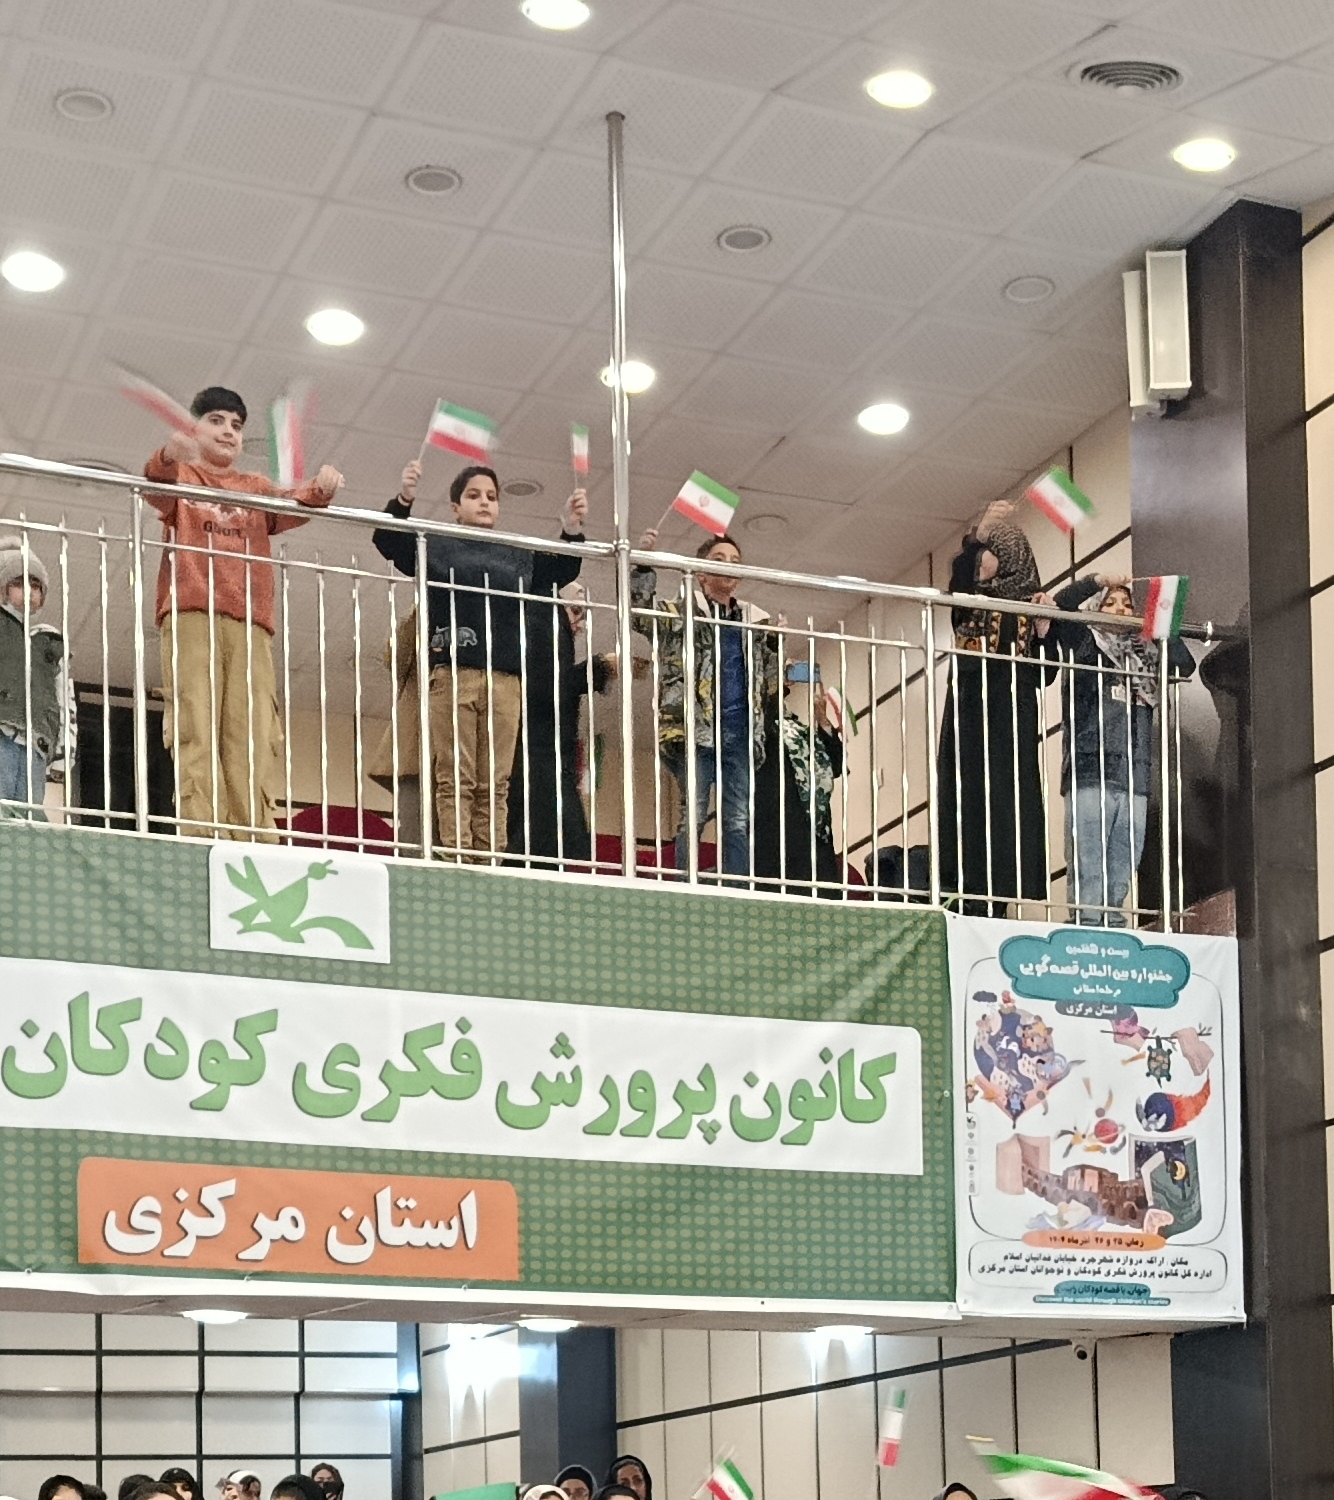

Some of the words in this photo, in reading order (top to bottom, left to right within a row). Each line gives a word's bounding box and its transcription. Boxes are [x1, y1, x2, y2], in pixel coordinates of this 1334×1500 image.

[1131, 967, 1173, 984] جشنواره
[1066, 1003, 1093, 1015] مرکزی
[1095, 1004, 1117, 1016] استان
[0, 991, 279, 1112] کودکان
[292, 1016, 483, 1122] فکری
[496, 1032, 722, 1144] پرورش
[728, 1047, 897, 1146] کانون
[103, 1178, 306, 1261] مرکزی
[325, 1185, 478, 1264] استان
[978, 1263, 1006, 1273] مرکزی
[1009, 1264, 1028, 1274] استان
[1074, 1266, 1101, 1276] کودکان
[1104, 1267, 1126, 1277] فکری
[1129, 1268, 1155, 1278] پرورش
